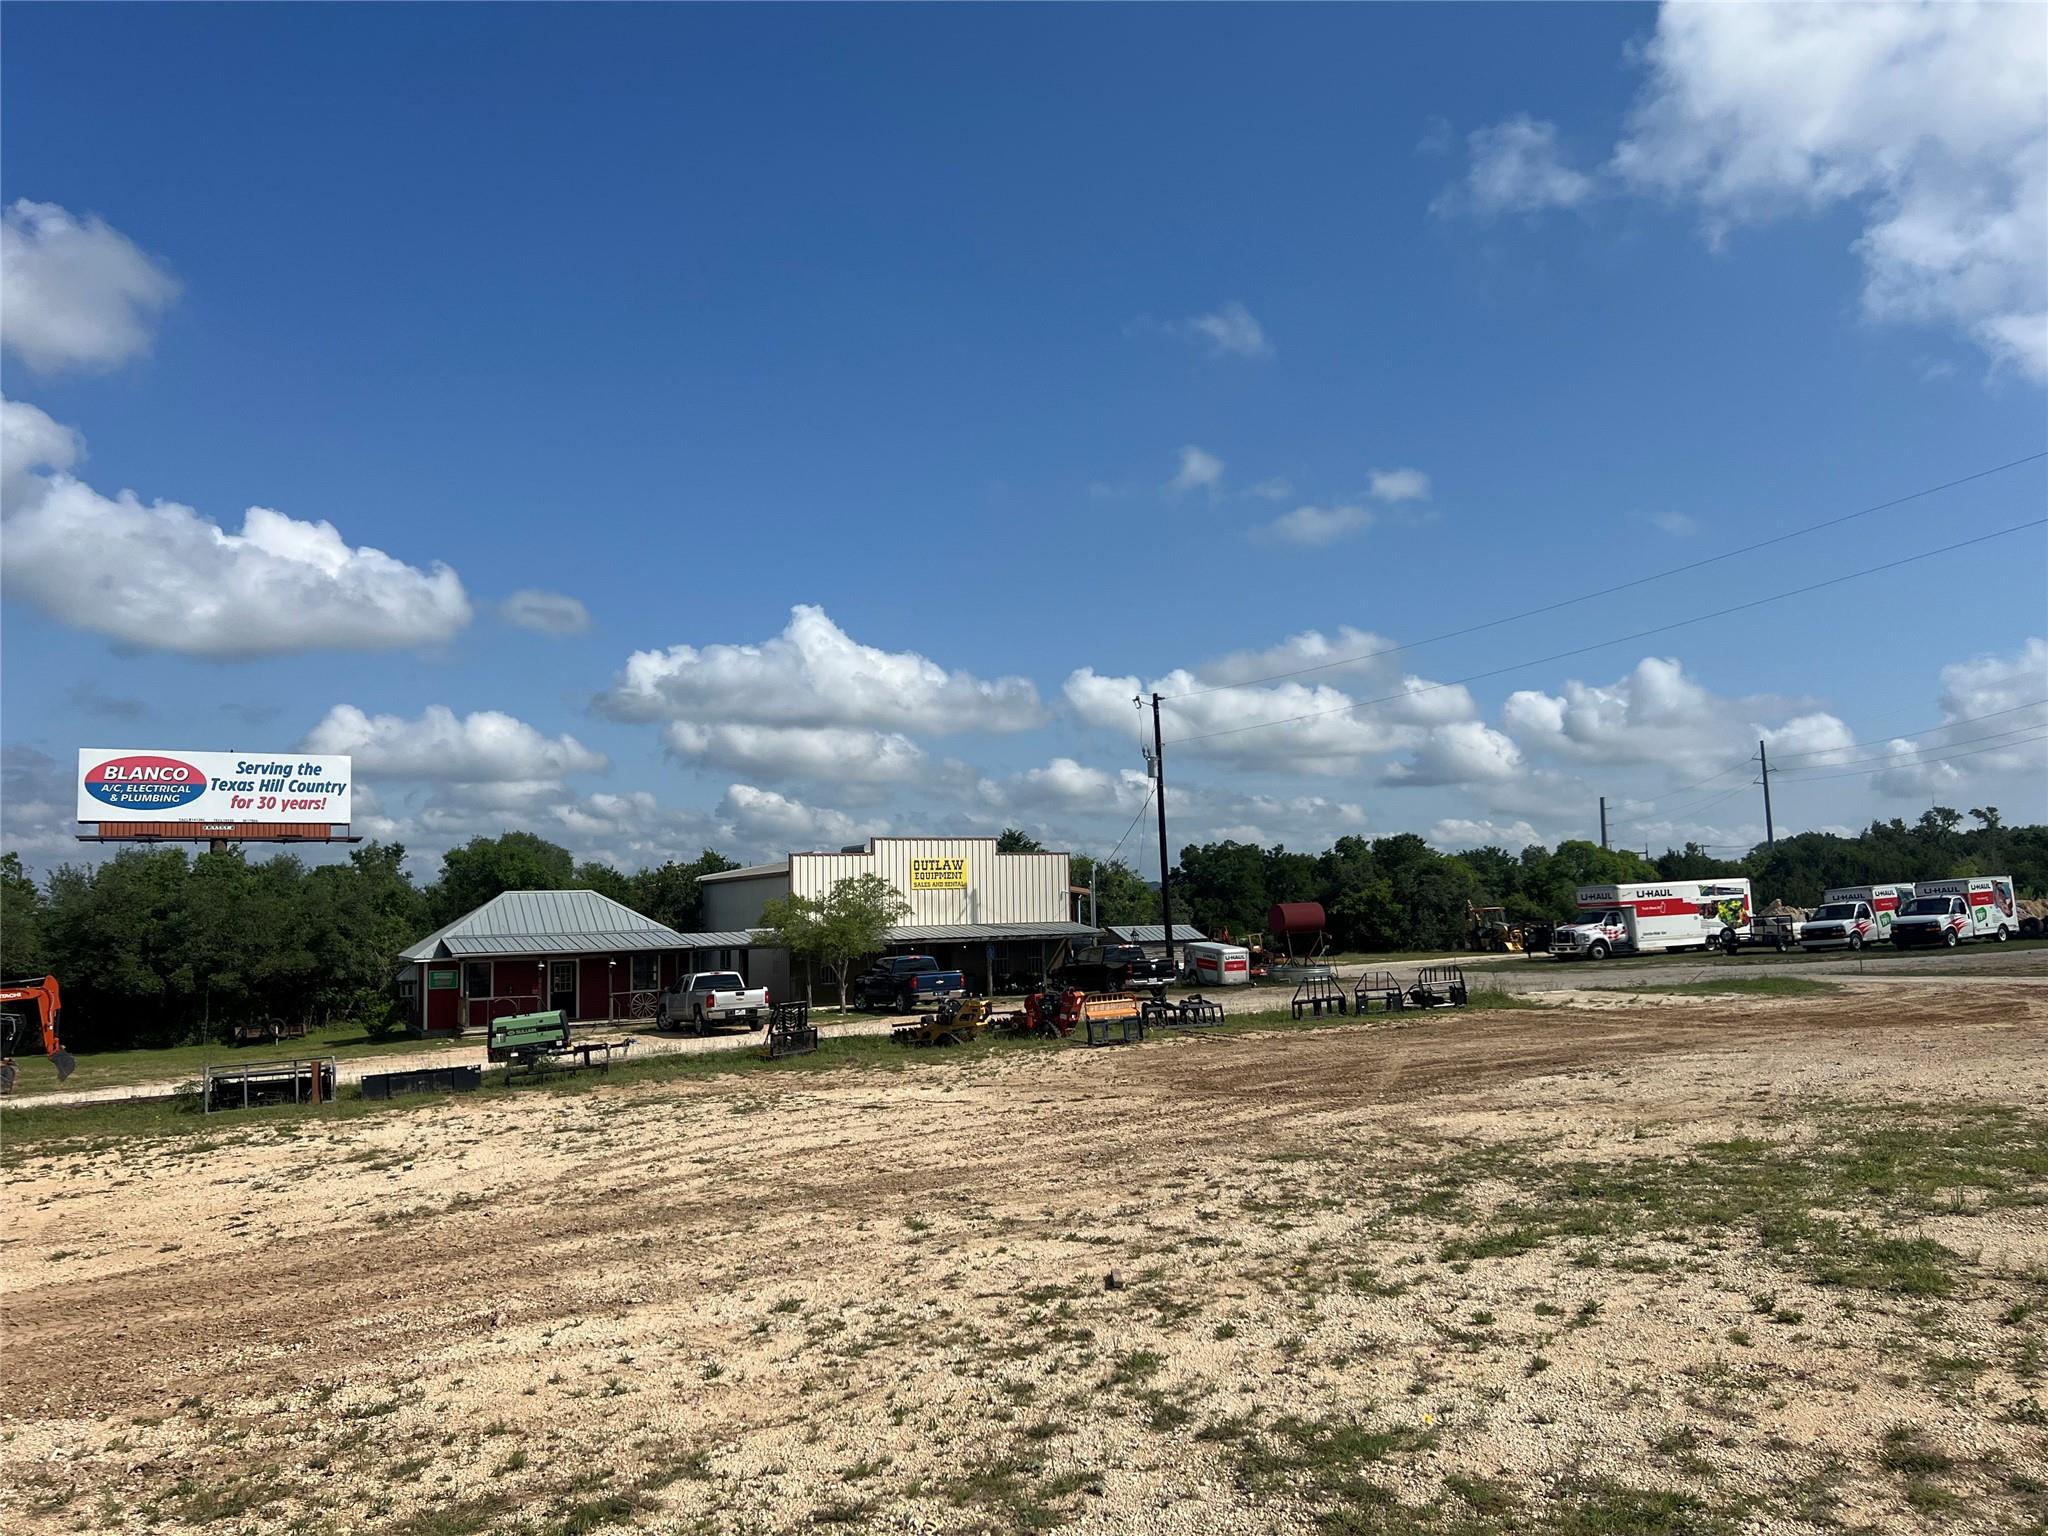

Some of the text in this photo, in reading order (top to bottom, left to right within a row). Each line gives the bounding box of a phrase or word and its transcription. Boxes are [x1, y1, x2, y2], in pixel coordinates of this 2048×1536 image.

[103, 766, 189, 782] BLANCO
[236, 761, 322, 778] Serving the
[101, 784, 191, 793] A/C, ELECTRICAL
[211, 778, 347, 796] Texas Hill Country
[110, 794, 180, 803] & PLUMBING
[230, 795, 327, 812] for 30 years!
[914, 860, 964, 870] OUTLAW
[915, 872, 963, 880] EQUIPMENT
[1636, 889, 1673, 898] U-HAUL
[1874, 889, 1895, 897] U-HAUL
[1923, 886, 1961, 894] U-HAUL
[1580, 892, 1613, 901] U-HAUL
[1832, 893, 1866, 901] U-HAUL
